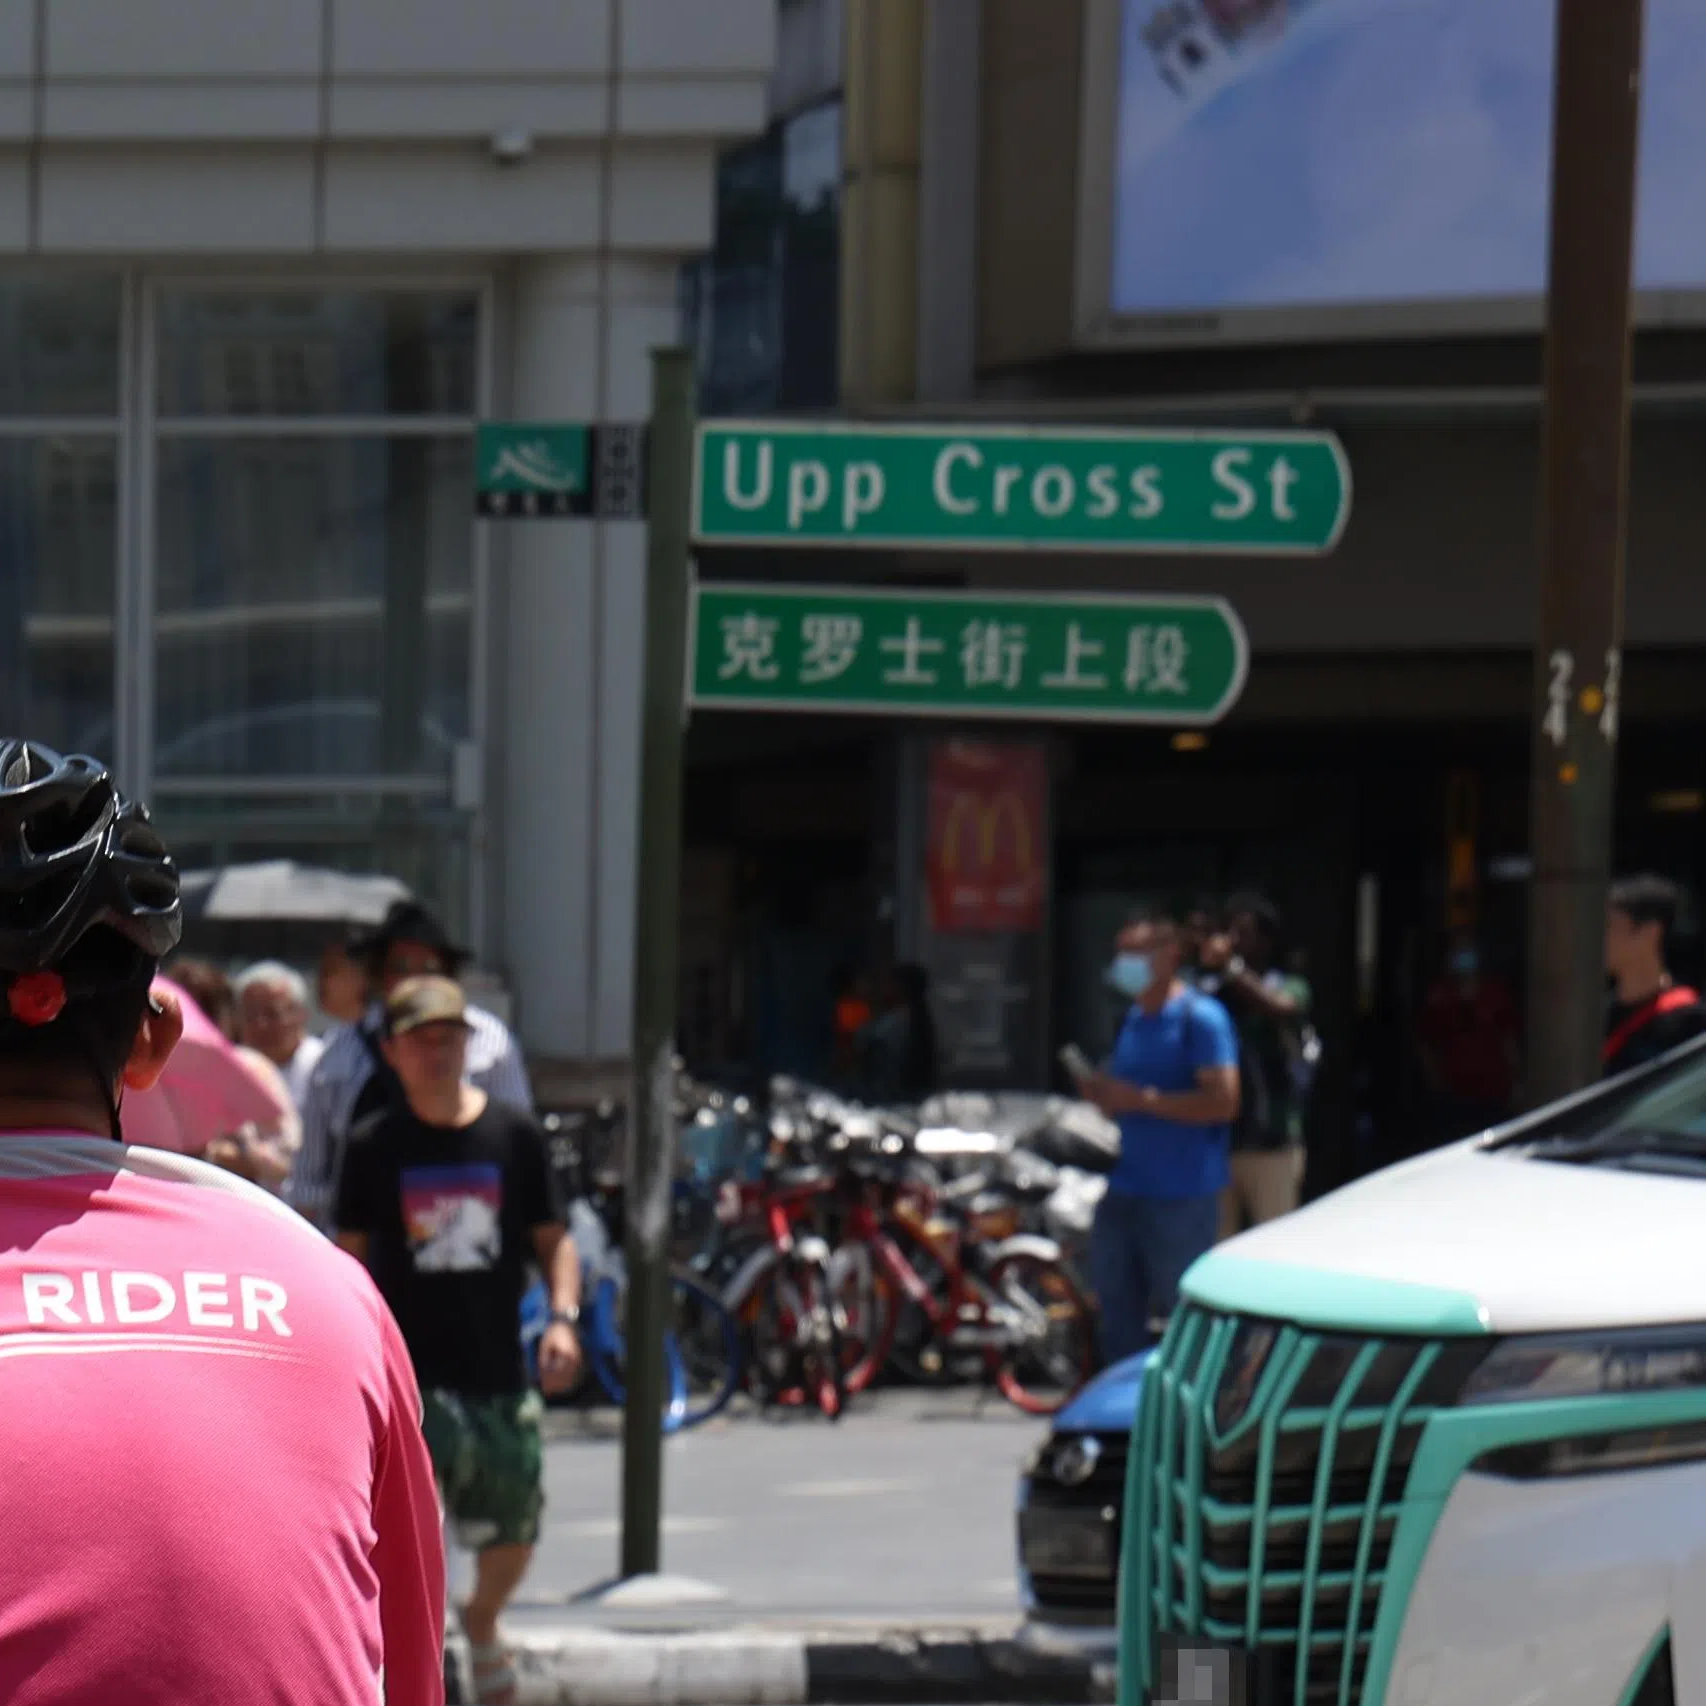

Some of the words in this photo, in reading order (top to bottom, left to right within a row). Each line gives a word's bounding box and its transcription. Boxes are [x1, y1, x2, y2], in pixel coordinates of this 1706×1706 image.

[722, 440, 886, 530] Upp
[933, 443, 1165, 520] Cross
[1211, 448, 1299, 521] St
[717, 610, 1189, 696] 克罗士街上段
[21, 1271, 293, 1337] RIDER
